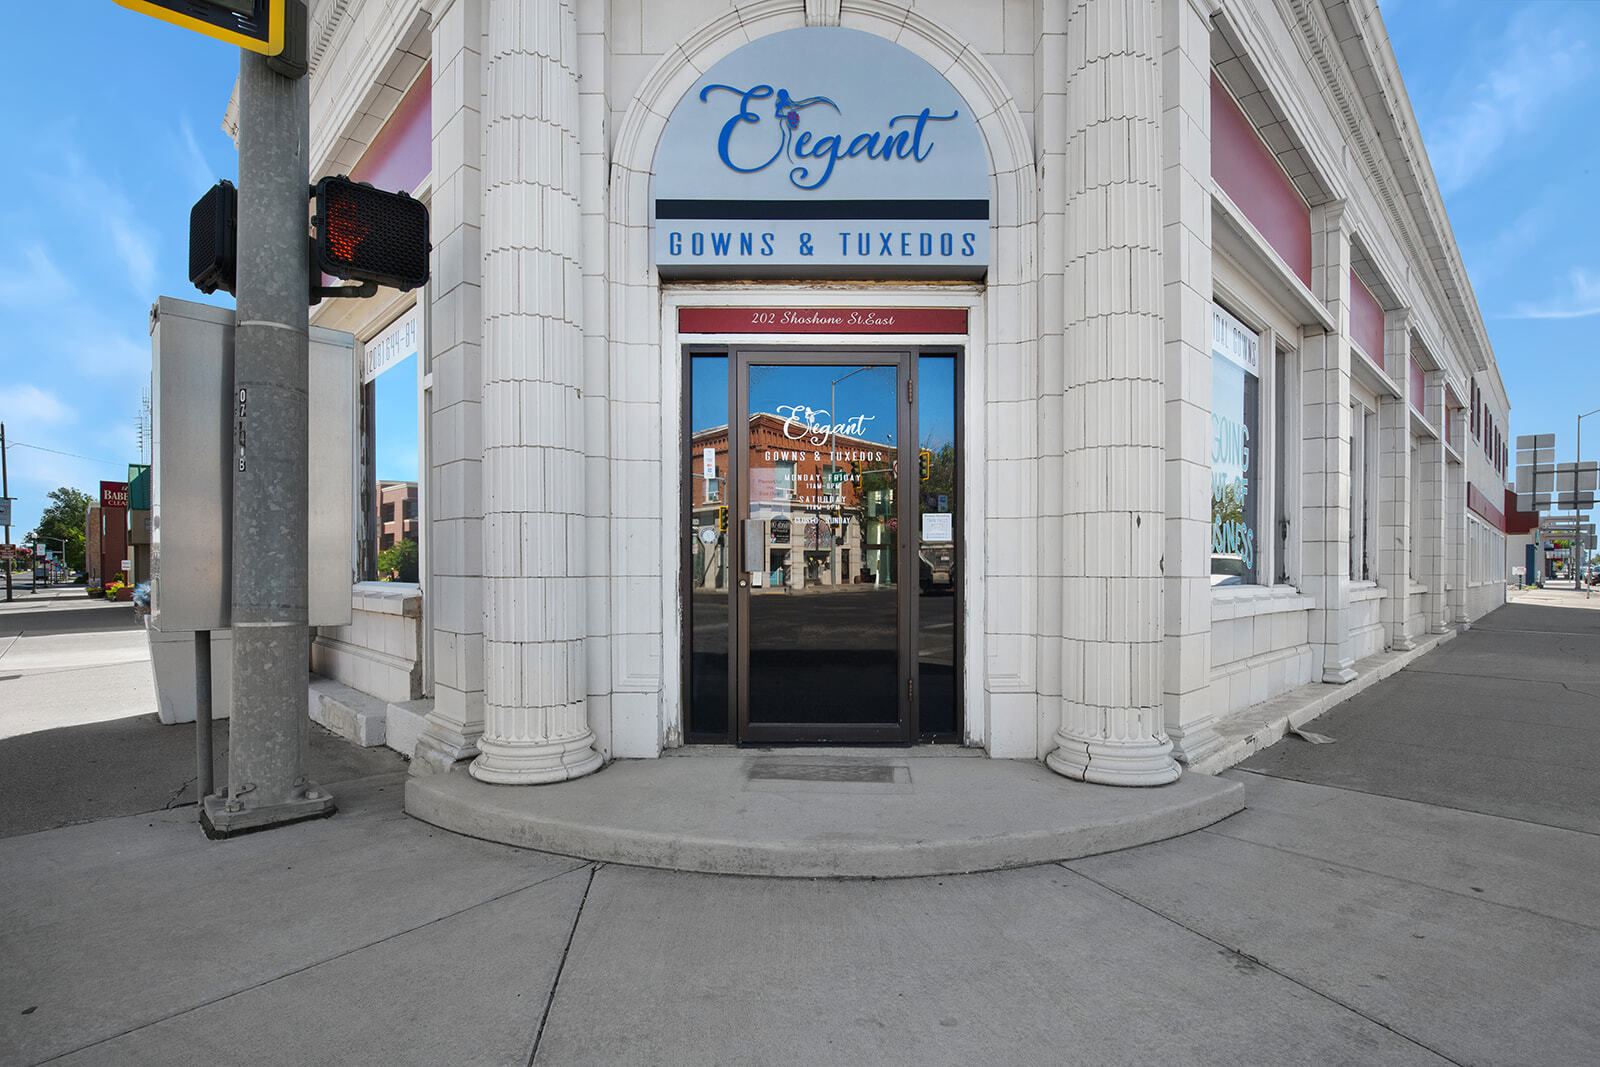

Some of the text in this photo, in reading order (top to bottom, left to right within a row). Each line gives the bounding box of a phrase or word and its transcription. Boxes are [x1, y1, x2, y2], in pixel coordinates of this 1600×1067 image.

[700, 84, 958, 190] Elegant
[669, 231, 976, 257] GOWNS & TUXEDOS
[751, 312, 775, 324] 202
[780, 311, 843, 325] Shoshone
[1232, 327, 1257, 367] GOWNS
[776, 405, 876, 447] Elegant
[764, 451, 882, 462] GOWNS & TUXEDOS
[1211, 413, 1249, 473] GOING
[799, 495, 847, 503] SATURDAY
[1234, 475, 1248, 506] OF
[825, 516, 851, 524] SUNDAY
